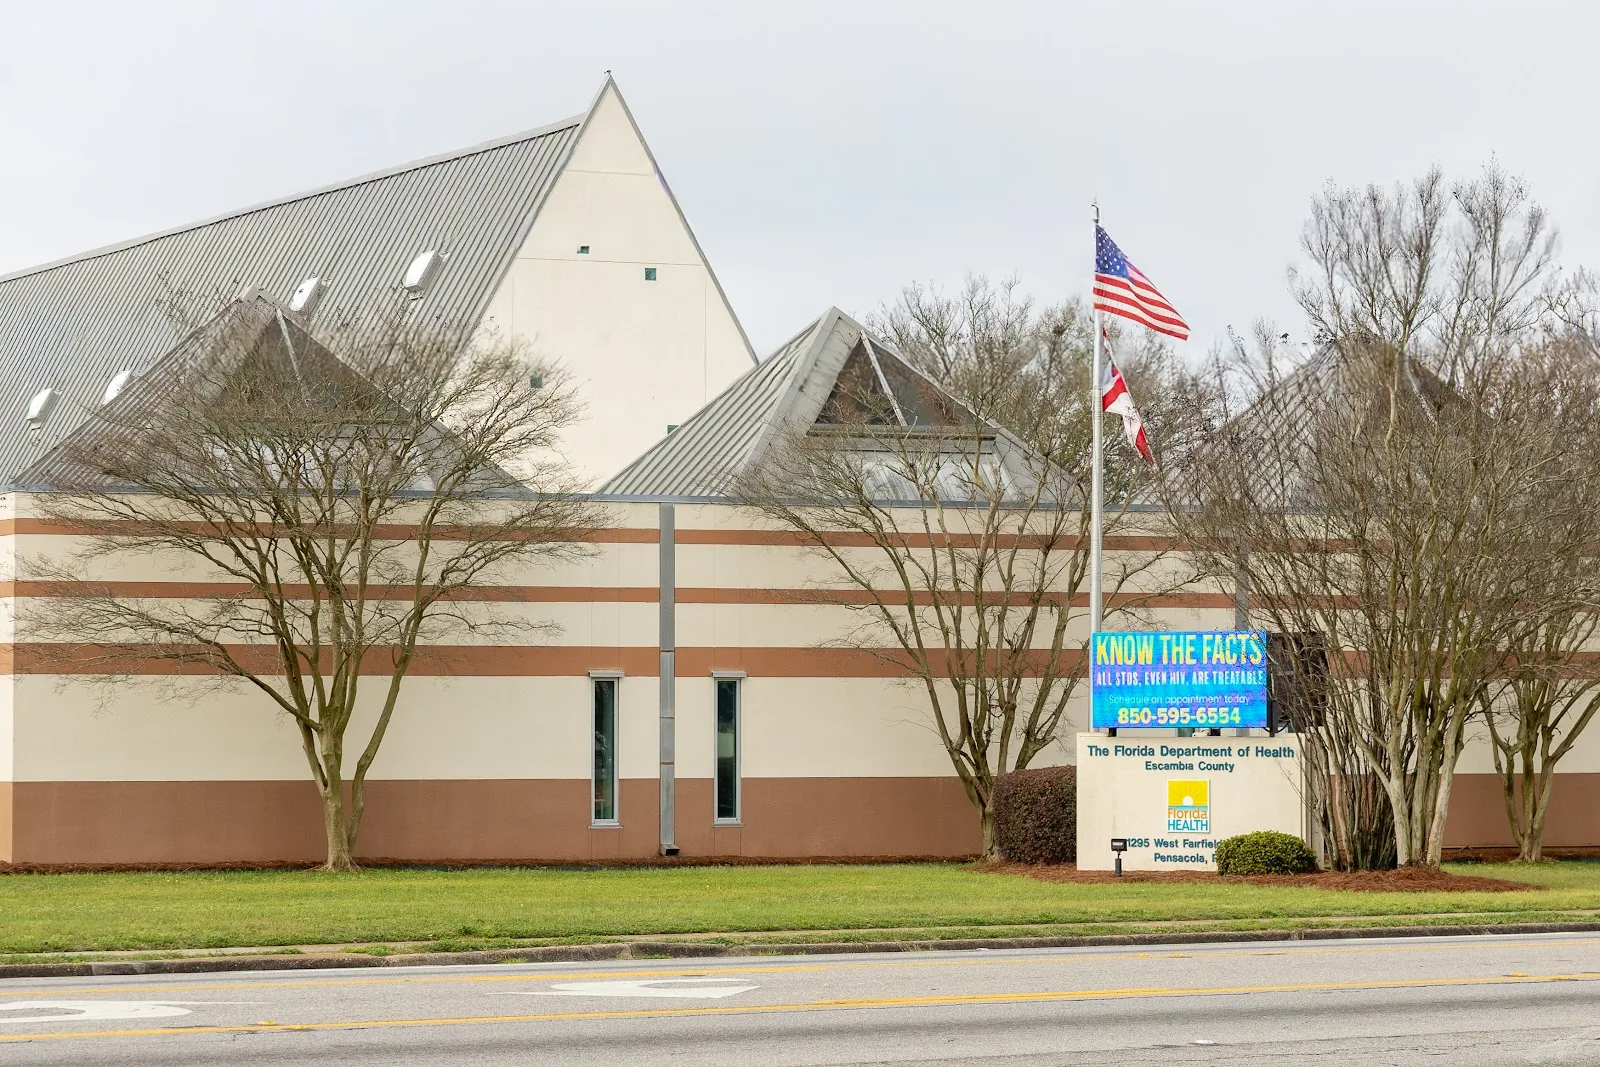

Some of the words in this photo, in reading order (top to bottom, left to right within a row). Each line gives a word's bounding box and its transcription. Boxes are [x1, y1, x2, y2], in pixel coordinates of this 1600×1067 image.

[1096, 635, 1153, 665] KNOW
[1159, 635, 1197, 664] THE
[1202, 634, 1262, 665] FACTS
[1096, 672, 1112, 686] ALL
[1144, 671, 1167, 685] EVEN
[1169, 671, 1189, 686] HIV,
[1191, 671, 1209, 685] ARE
[1109, 694, 1149, 704] Schedule
[1165, 694, 1222, 706] appointment
[1117, 707, 1241, 725] 850-595-6554
[1087, 745, 1110, 757] The
[1114, 745, 1155, 757] Florida
[1160, 745, 1232, 759] Department
[1237, 746, 1250, 757] of
[1255, 746, 1295, 758] Health
[1145, 761, 1194, 771] Escambia
[1198, 761, 1235, 773] County
[1167, 806, 1208, 820] Florida
[1167, 819, 1209, 831] HEALTH
[1127, 838, 1150, 848] 1295
[1154, 838, 1179, 848] West
[1154, 852, 1208, 864] Pensacola,
